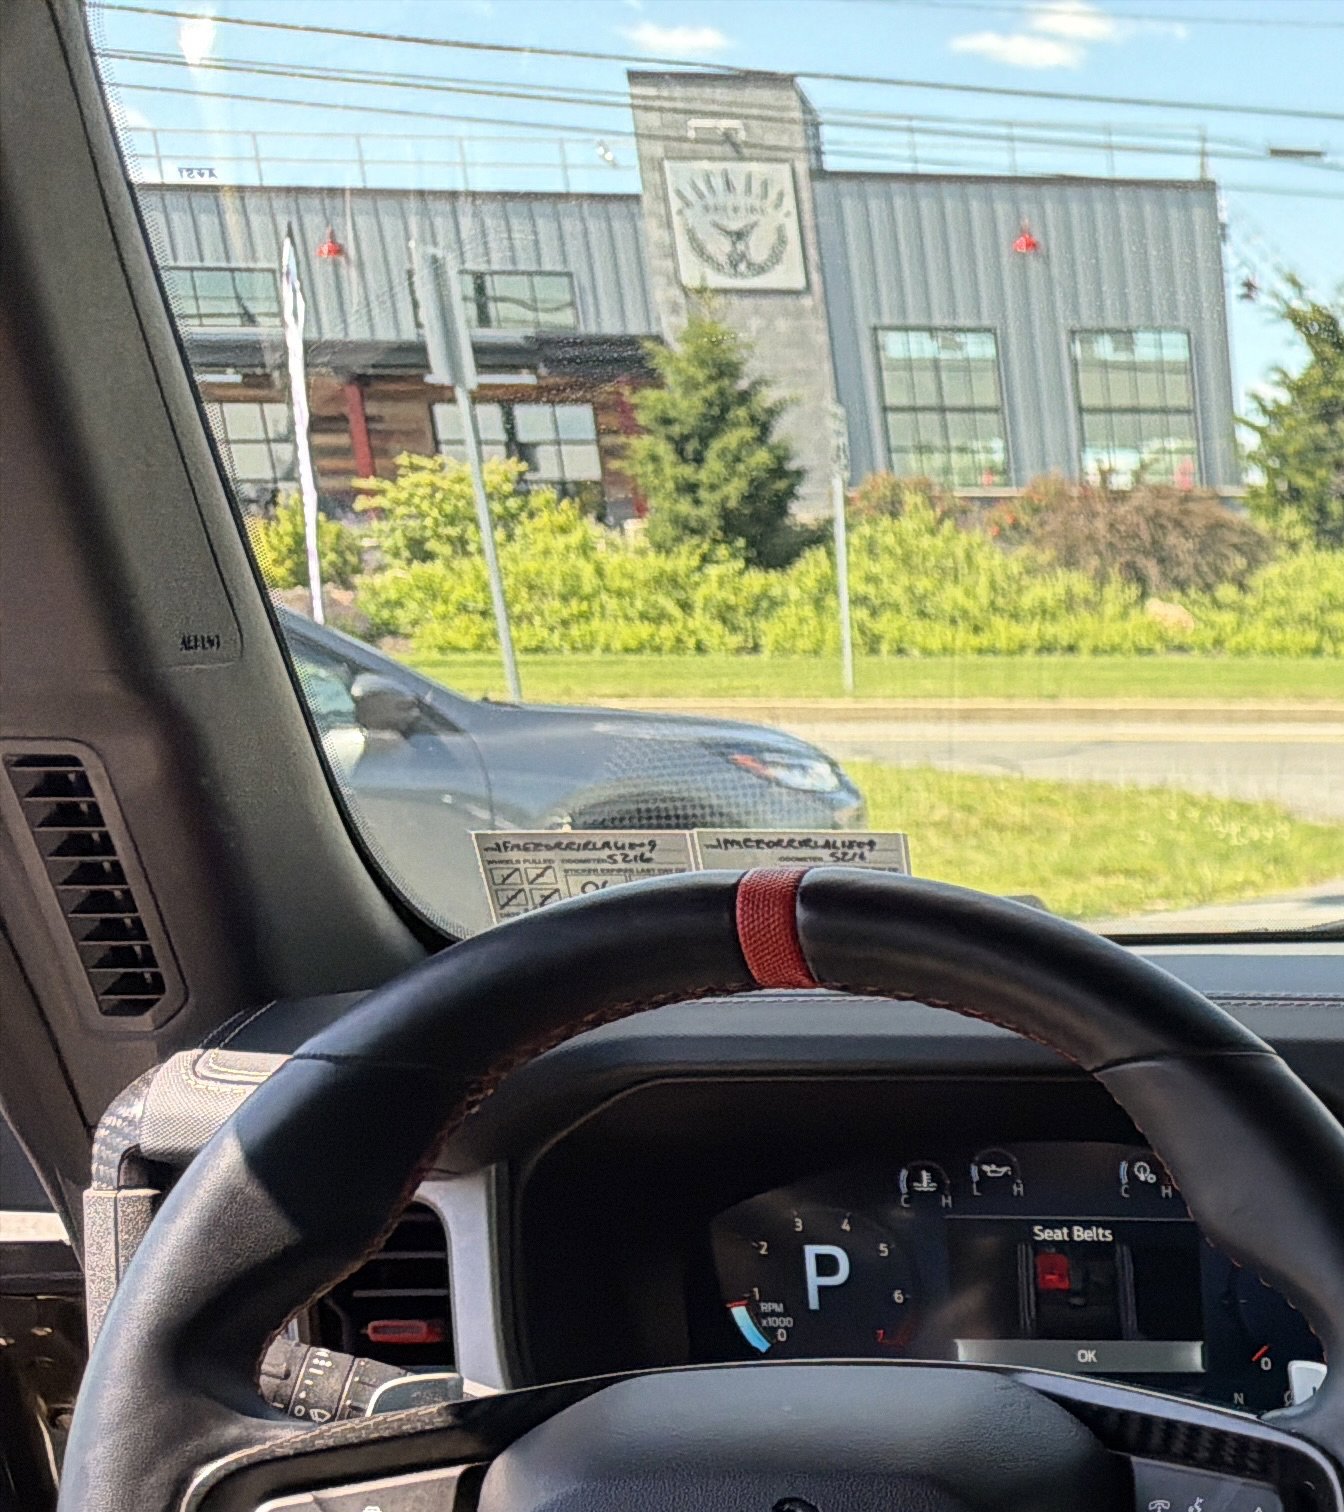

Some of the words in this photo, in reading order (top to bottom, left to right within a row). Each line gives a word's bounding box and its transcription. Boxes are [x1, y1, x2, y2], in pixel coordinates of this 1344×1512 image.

[1013, 1183, 1024, 1197] H
[1121, 1184, 1130, 1198] C
[1161, 1185, 1172, 1198] H
[901, 1194, 911, 1208] C
[942, 1195, 952, 1208] H
[794, 1218, 803, 1232] 3
[841, 1218, 851, 1232] 4
[1033, 1226, 1069, 1241] Seat
[1073, 1226, 1113, 1241] Belts
[759, 1241, 768, 1255] 2
[879, 1242, 889, 1257] 5
[803, 1244, 850, 1310] P
[753, 1288, 760, 1300] 1
[893, 1289, 904, 1304] 6
[760, 1302, 784, 1313] RPM
[762, 1316, 793, 1328] x1000
[777, 1328, 787, 1342] 0
[1077, 1349, 1097, 1363] OK
[1260, 1356, 1272, 1371] 0
